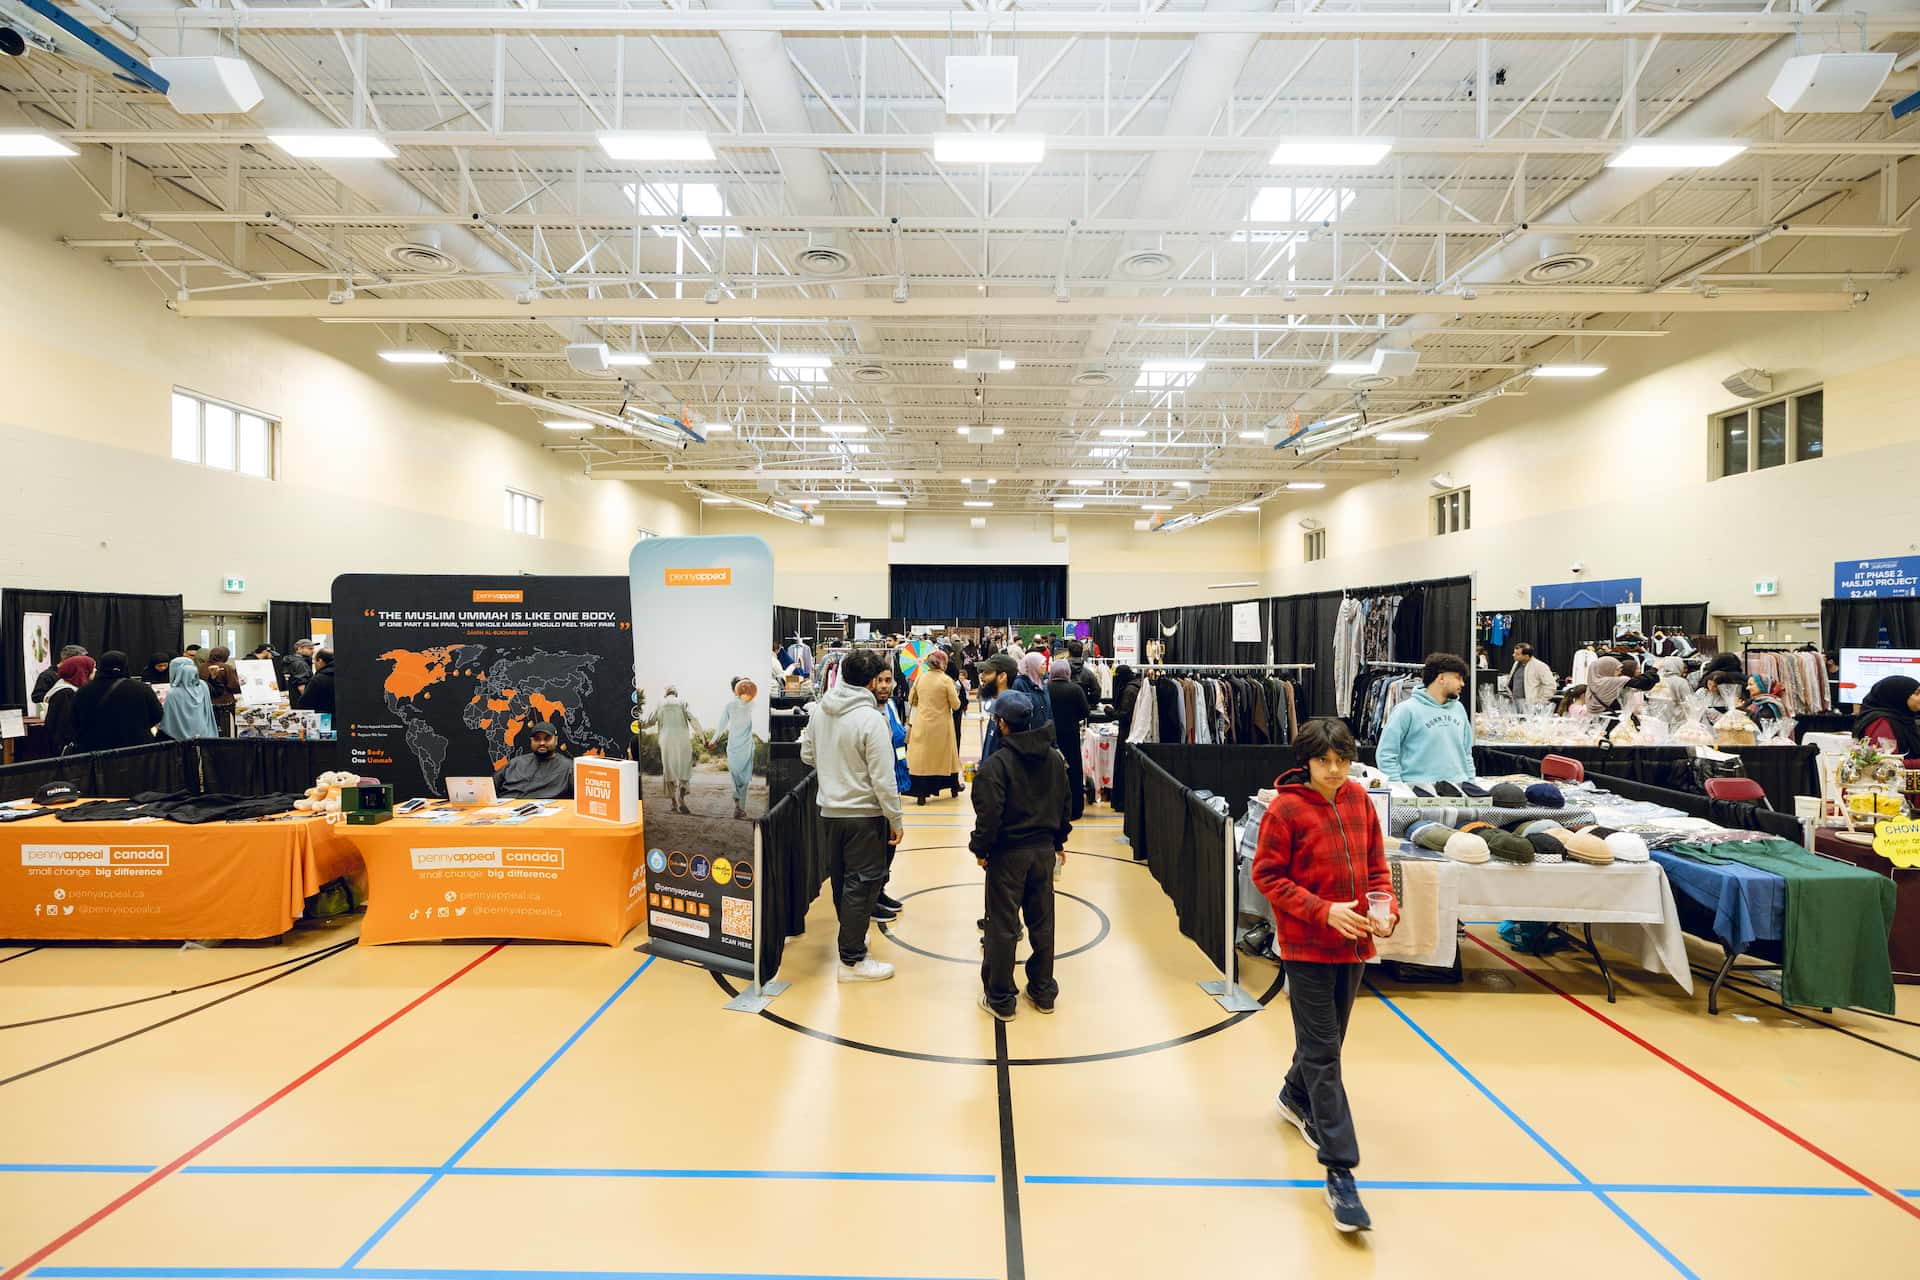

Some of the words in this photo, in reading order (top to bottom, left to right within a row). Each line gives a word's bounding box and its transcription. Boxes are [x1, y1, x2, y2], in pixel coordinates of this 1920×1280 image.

[1854, 572, 1866, 580] IIT
[1866, 570, 1896, 579] PHASE
[1896, 569, 1904, 578] 2
[1841, 579, 1874, 588] MASJID
[1875, 576, 1919, 586] PROJECT
[378, 611, 402, 620] THE
[404, 611, 456, 620] MUSLIM
[458, 611, 508, 620] UMMAH
[511, 611, 522, 620] IS
[525, 611, 551, 620] LIKE
[553, 611, 579, 620] ONE
[581, 611, 616, 620] BODY.
[351, 748, 366, 756] One
[367, 748, 385, 757] Body
[351, 756, 366, 764] One
[367, 756, 393, 764] Ummah
[585, 777, 612, 789] DONATE
[585, 785, 611, 800] NOW
[28, 849, 104, 862] pennyappeal
[113, 849, 164, 860] canada
[417, 851, 496, 866] pennyappeal
[505, 851, 559, 864] canada
[28, 867, 52, 877] small
[95, 867, 112, 878] big
[114, 867, 164, 877] difference
[418, 869, 443, 880] small
[487, 868, 505, 880] big
[507, 868, 559, 880] difference
[721, 937, 737, 946] SCAN
[737, 940, 753, 950] HERE
